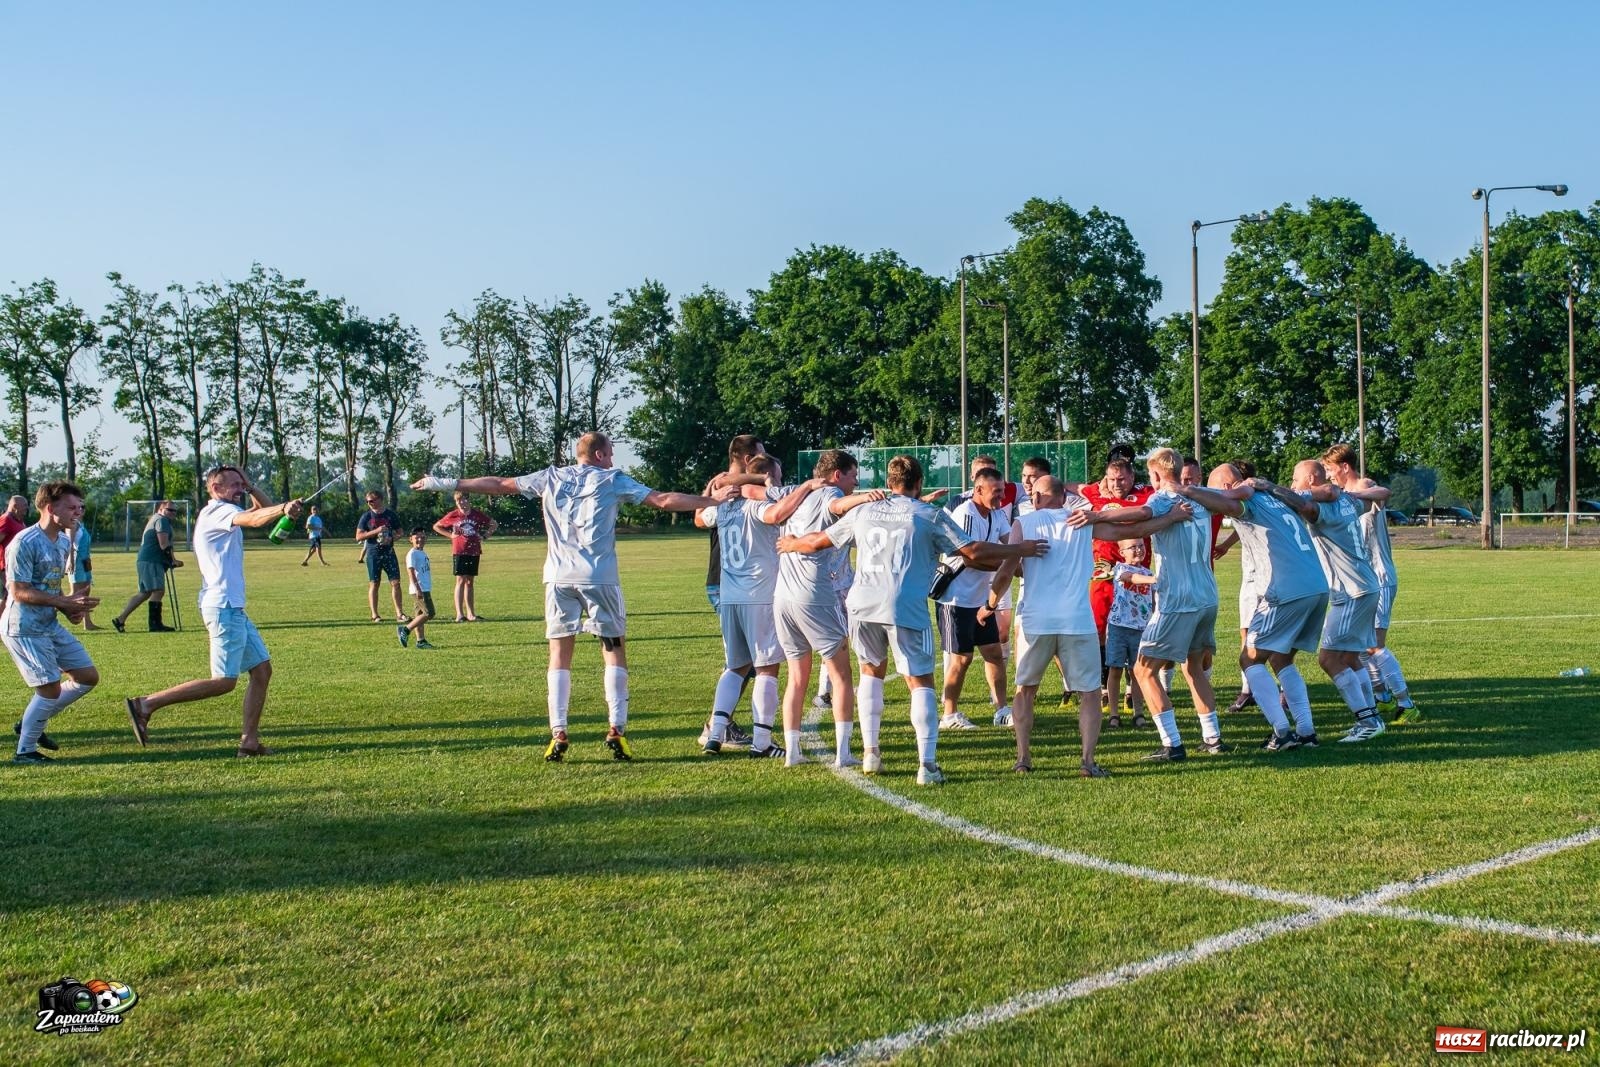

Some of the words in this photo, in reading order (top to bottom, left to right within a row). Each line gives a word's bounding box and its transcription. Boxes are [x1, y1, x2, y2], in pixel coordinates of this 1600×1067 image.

[718, 525, 746, 569] 18
[862, 526, 907, 574] 21
[1282, 513, 1311, 552] 2
